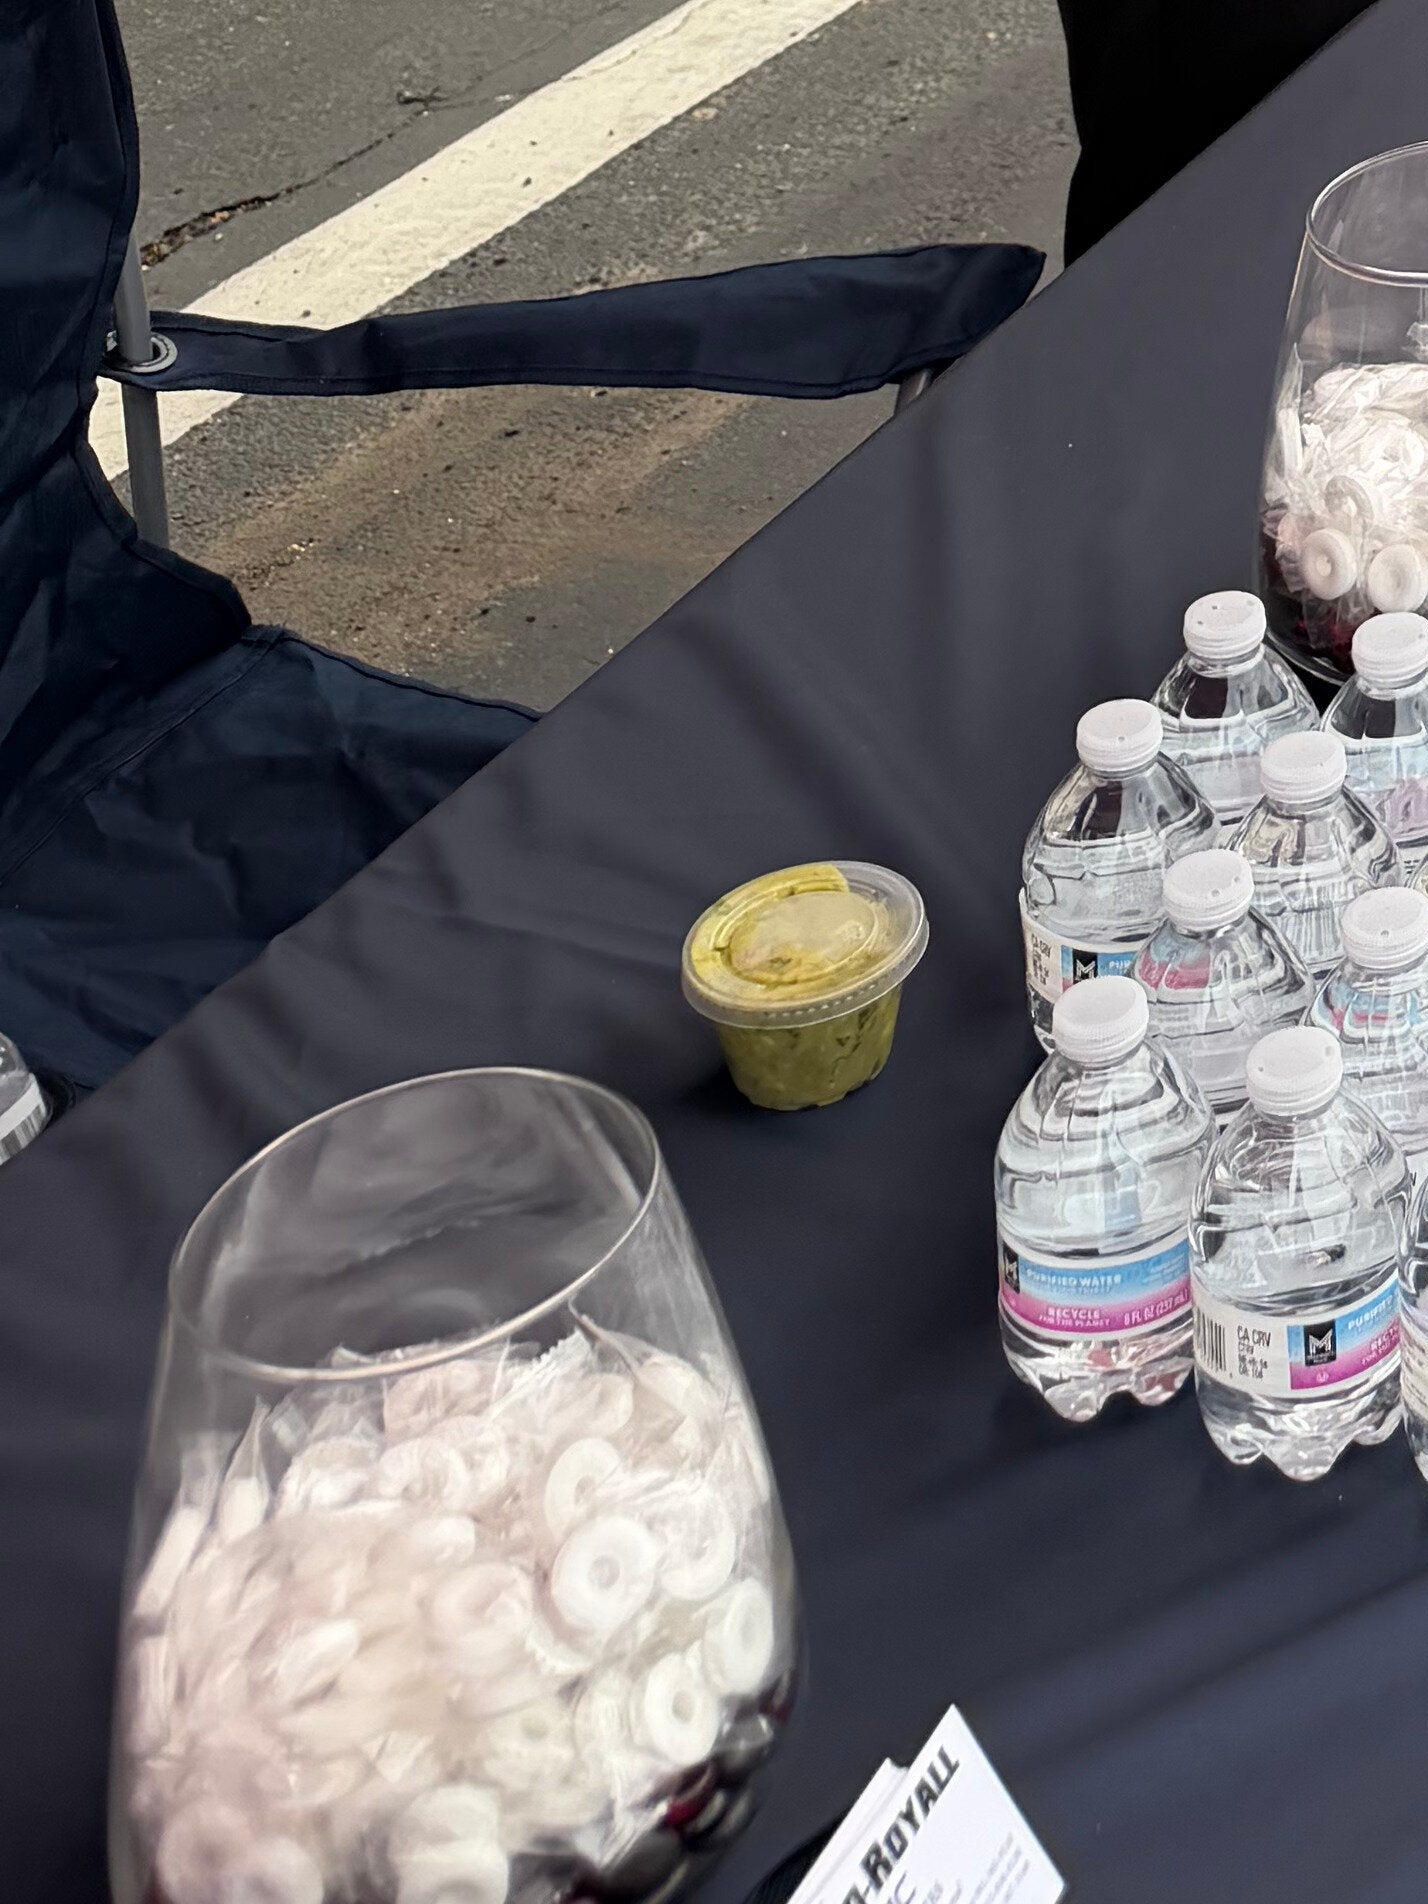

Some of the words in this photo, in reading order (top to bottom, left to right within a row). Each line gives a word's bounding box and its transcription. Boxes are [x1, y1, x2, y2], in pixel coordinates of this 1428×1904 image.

[1026, 1269, 1077, 1287] PURIFIED
[1080, 1273, 1123, 1288] WATER
[1047, 1306, 1101, 1320] RECYCLE
[1236, 1324, 1250, 1343] CA
[1251, 1330, 1272, 1348] CRV
